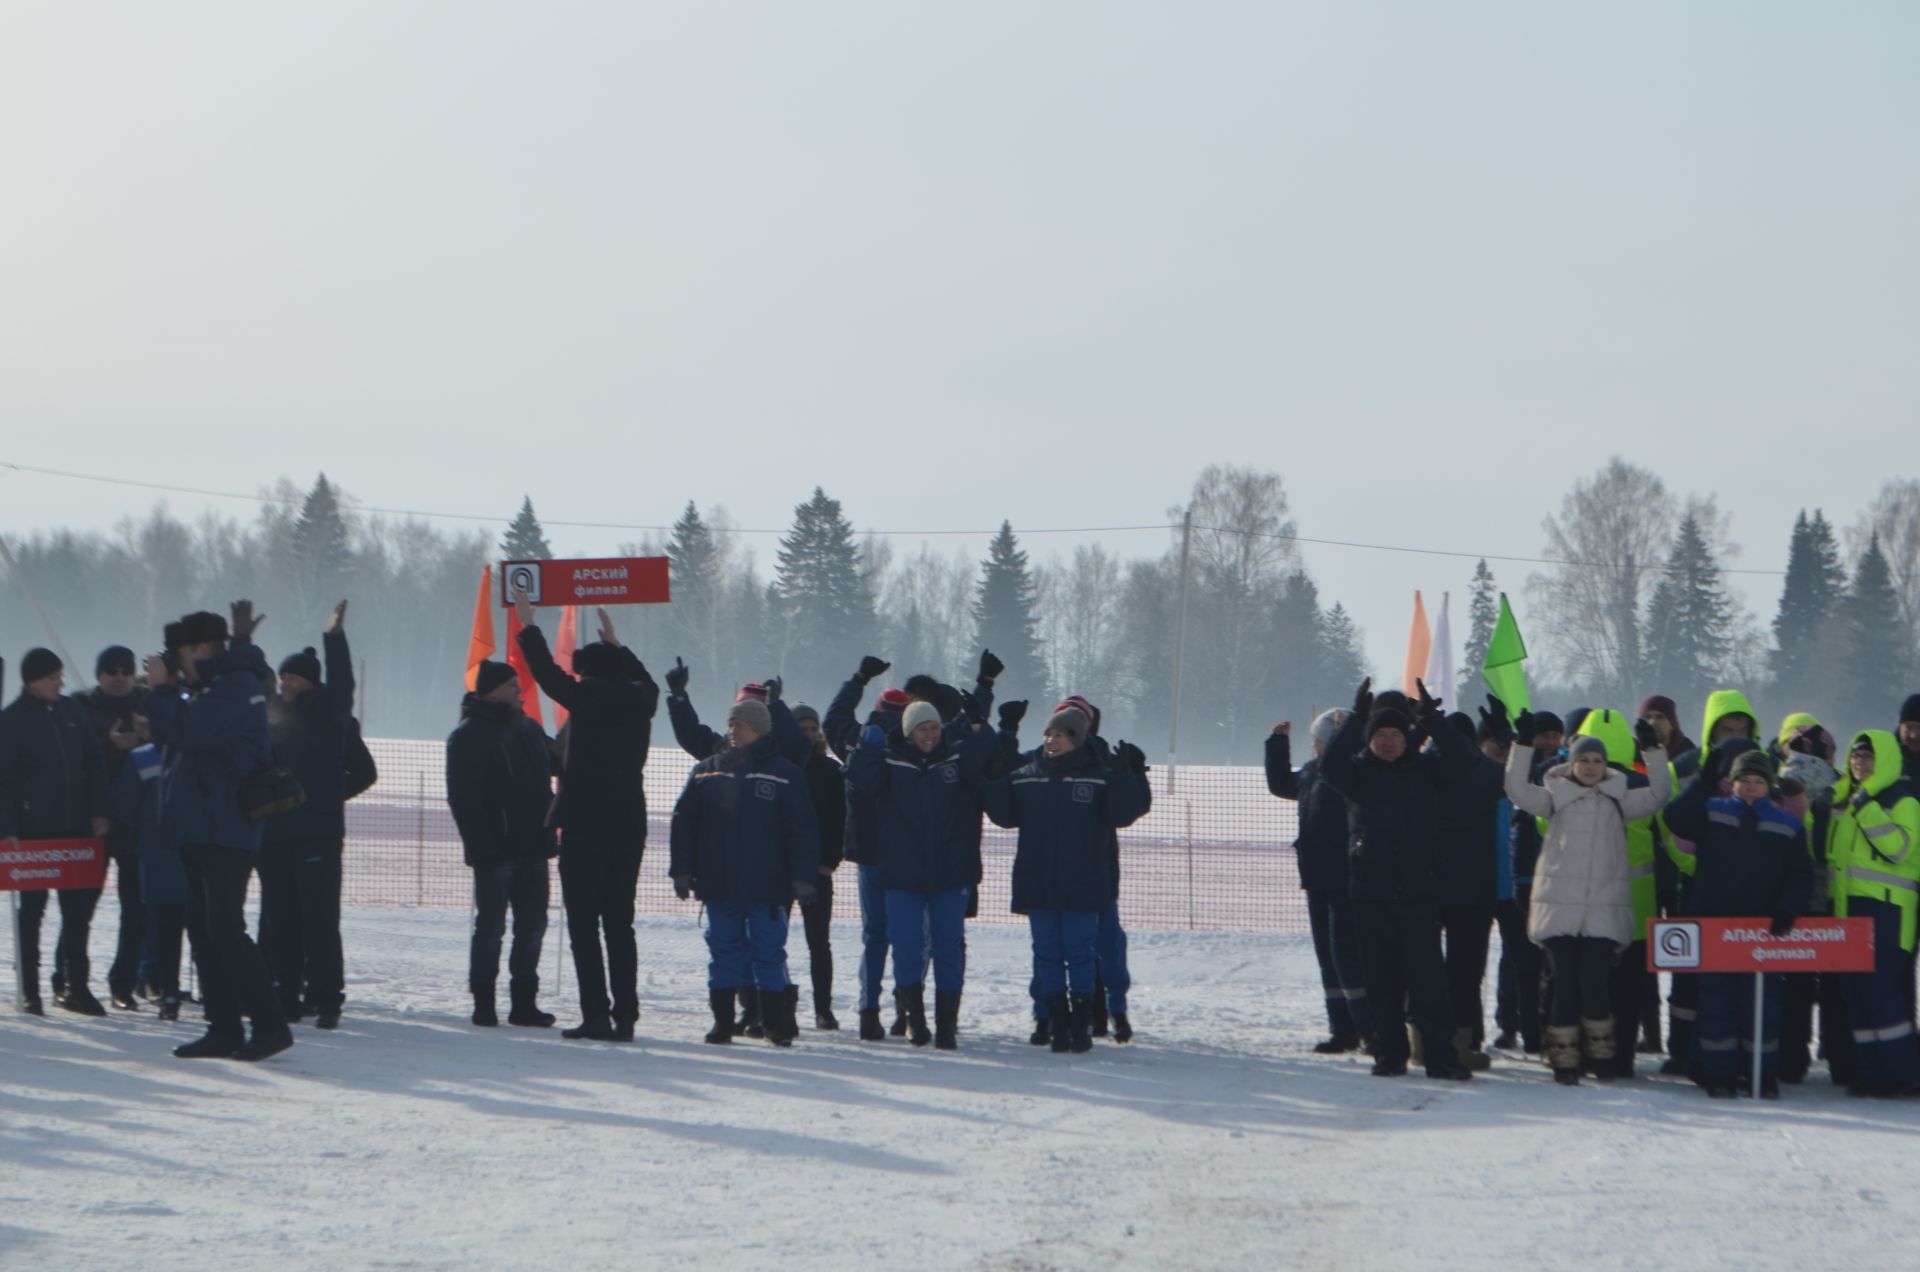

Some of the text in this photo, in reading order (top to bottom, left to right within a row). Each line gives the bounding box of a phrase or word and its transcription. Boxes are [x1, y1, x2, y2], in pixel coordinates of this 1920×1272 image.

[573, 565, 629, 581] АРСКИЙ
[574, 584, 629, 599] филиал
[1721, 926, 1847, 943] АПАСВСКИЙ
[1751, 945, 1817, 962] филиал
